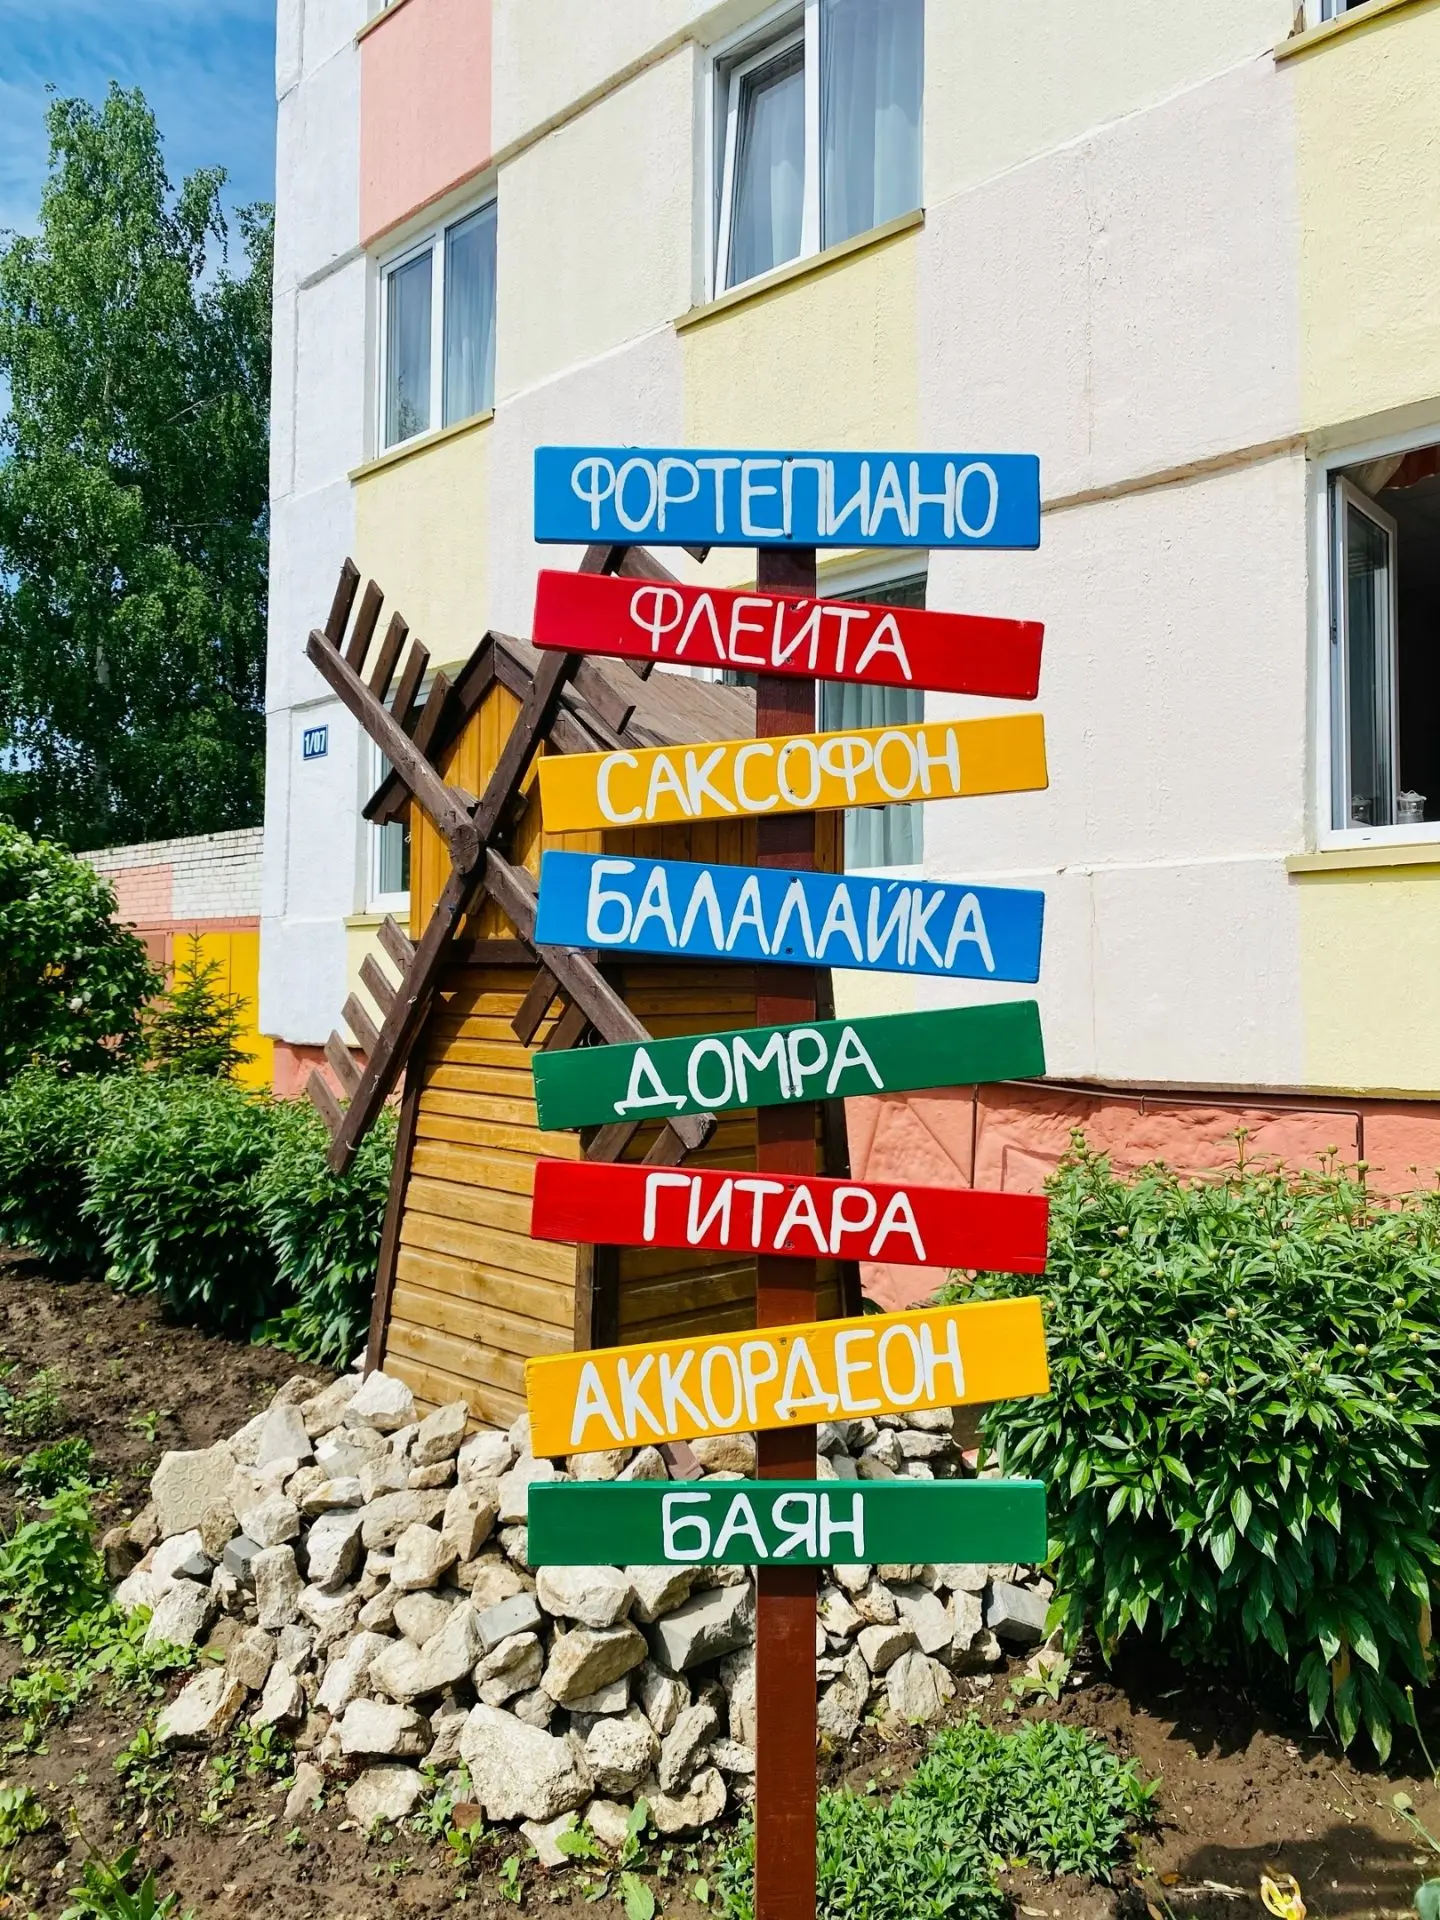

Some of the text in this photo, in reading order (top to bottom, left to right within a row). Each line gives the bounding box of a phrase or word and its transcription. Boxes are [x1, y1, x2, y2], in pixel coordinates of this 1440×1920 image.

[571, 457, 998, 538] ФОРТЕПИАНО
[630, 586, 913, 680] ФЛЕЙТА
[597, 728, 961, 824] САКСОФОН
[586, 859, 995, 972] БАЛАЛАЙКА
[613, 1026, 884, 1116] ДОМРА
[643, 1172, 926, 1261] ГИТАРА
[570, 1319, 965, 1445] АККОРДЕОН
[662, 1492, 865, 1561] БАЯН
